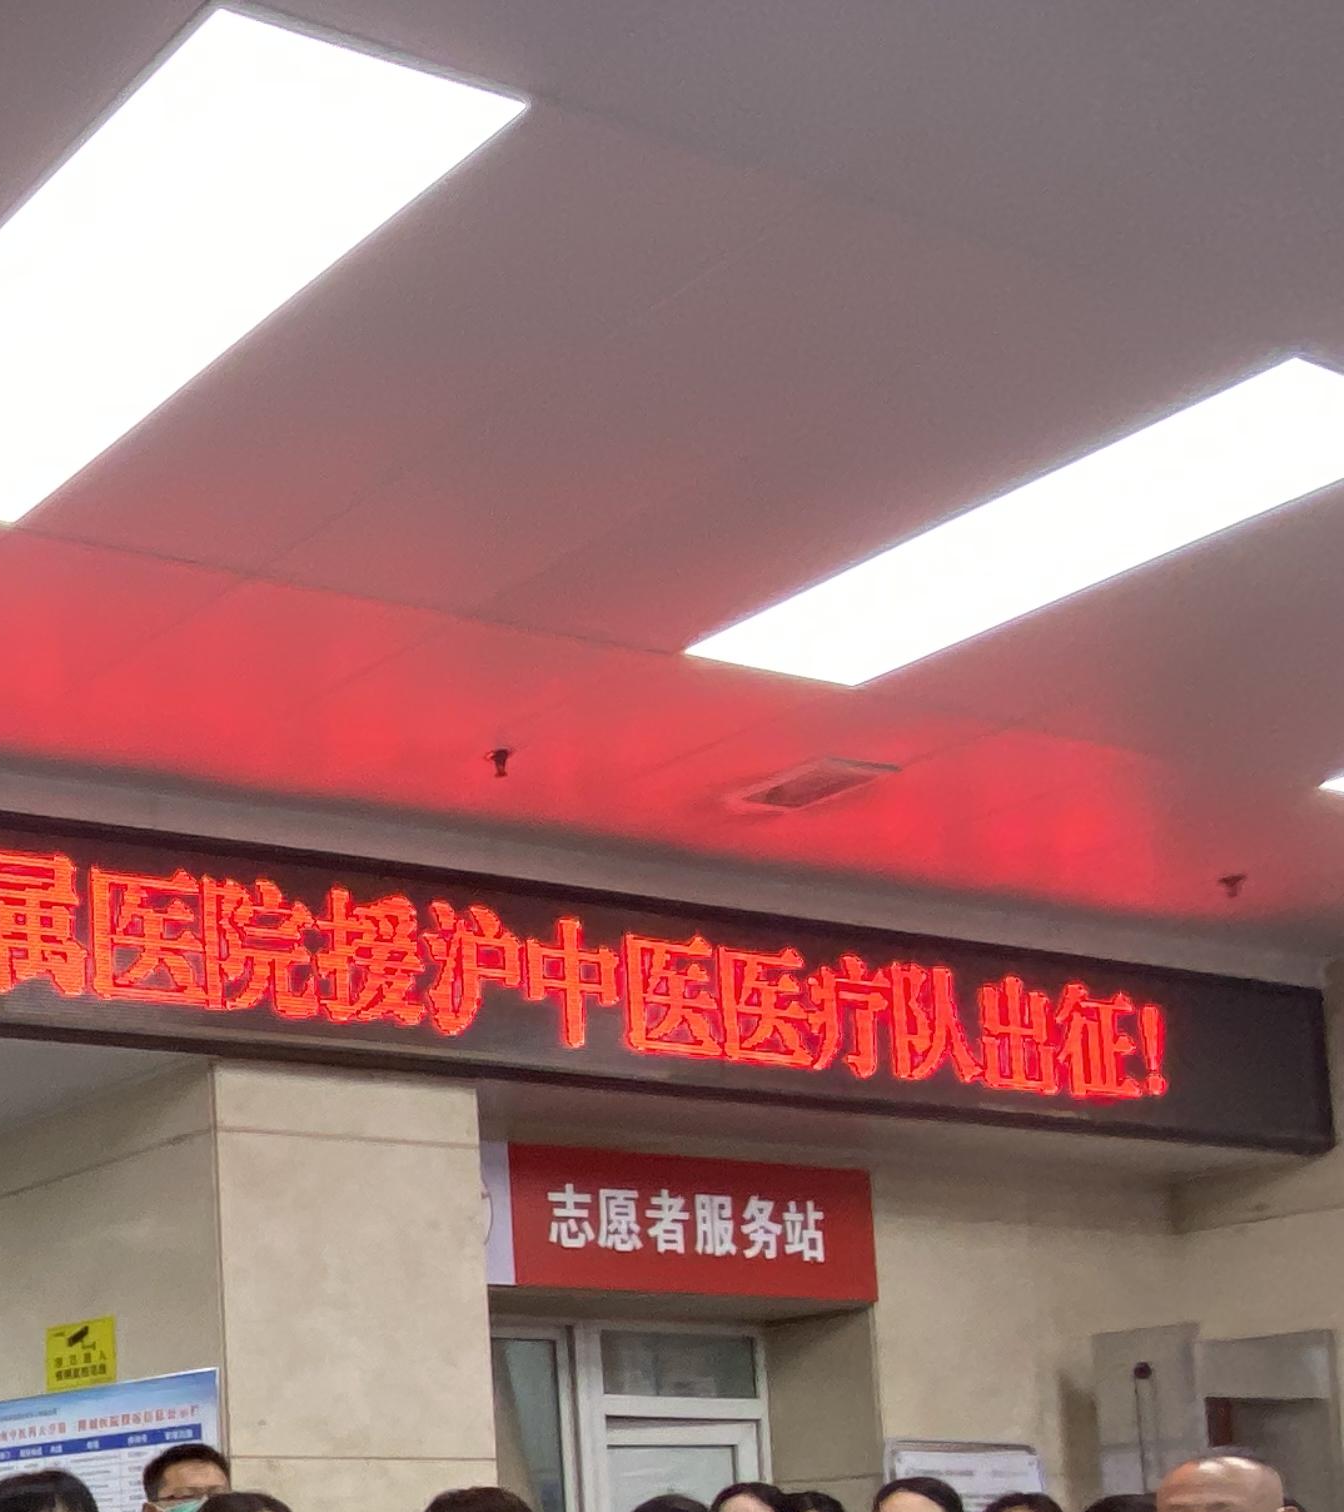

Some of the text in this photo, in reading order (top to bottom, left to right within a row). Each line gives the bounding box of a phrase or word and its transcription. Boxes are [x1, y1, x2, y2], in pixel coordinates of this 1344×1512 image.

[546, 1182, 828, 1265] 志愿者服务站
